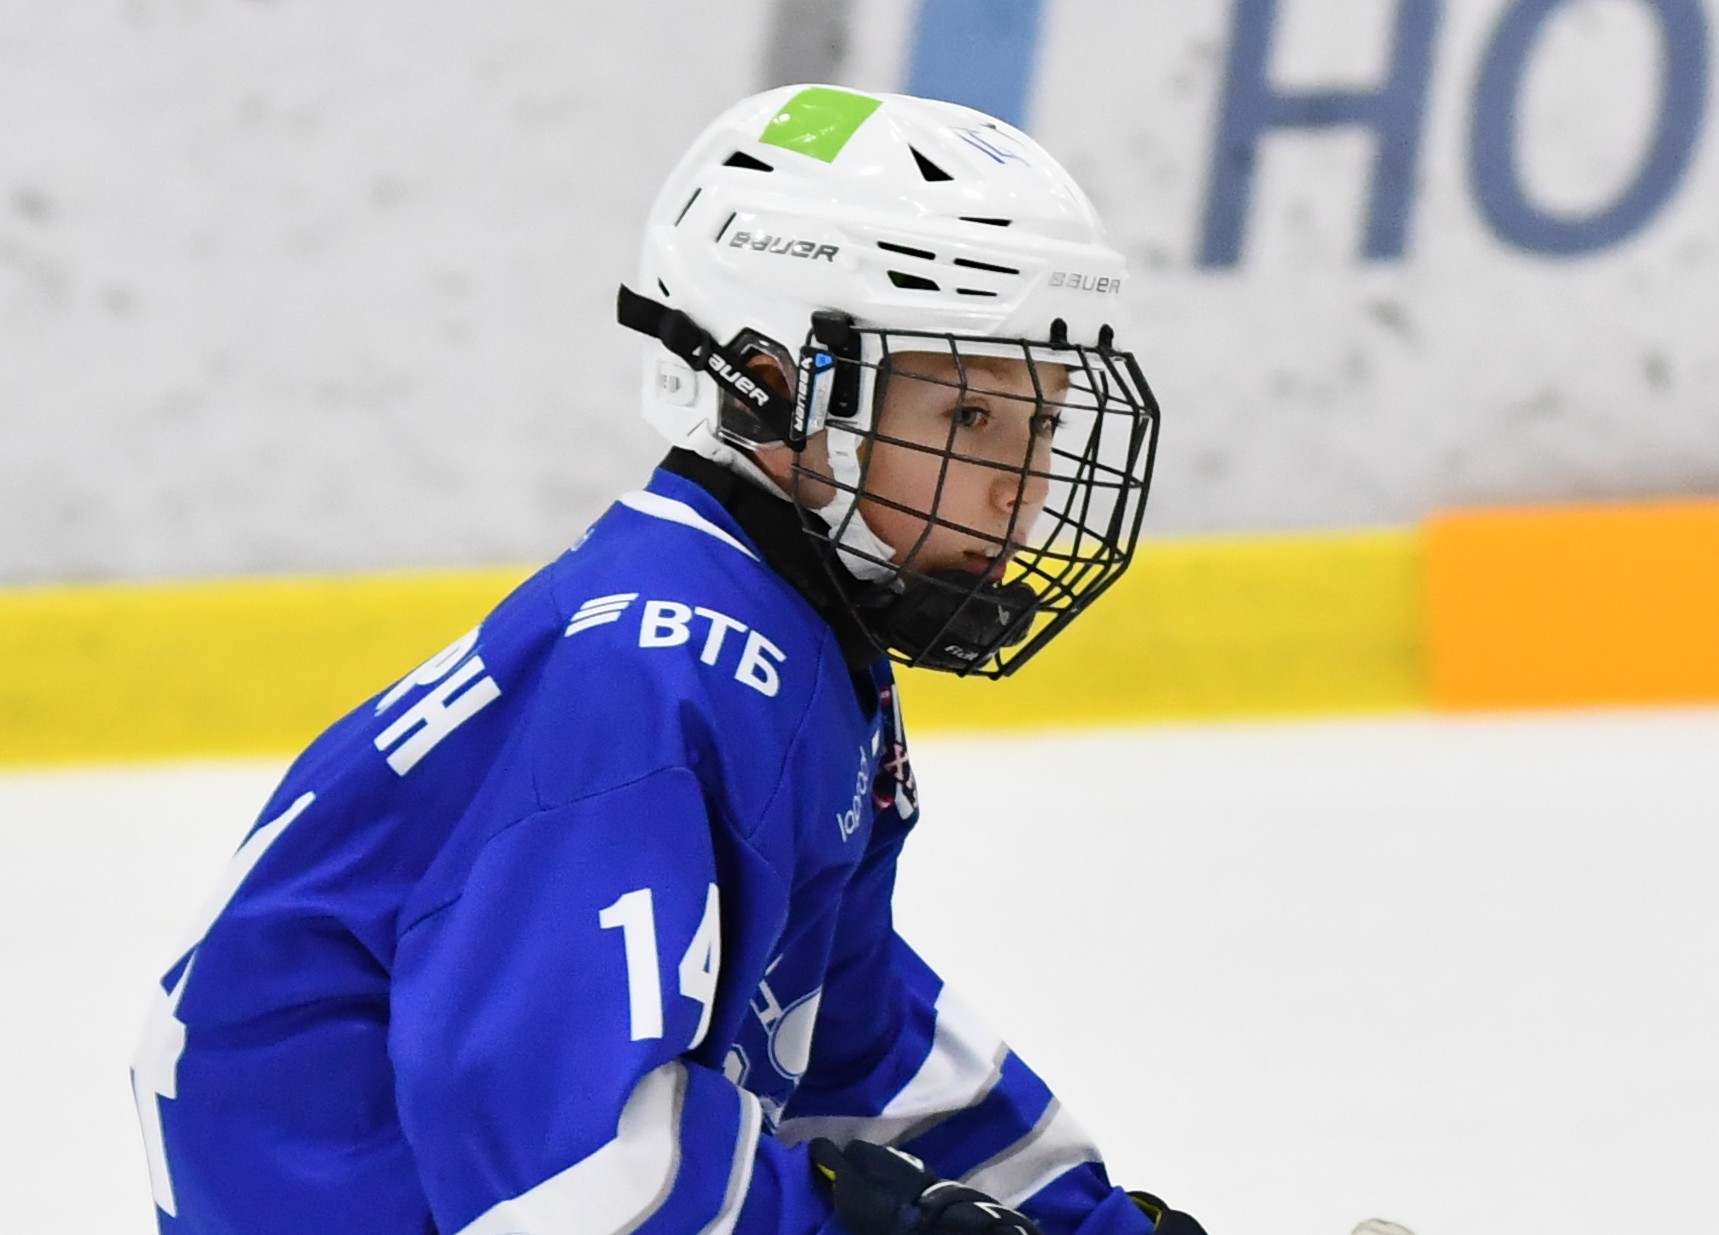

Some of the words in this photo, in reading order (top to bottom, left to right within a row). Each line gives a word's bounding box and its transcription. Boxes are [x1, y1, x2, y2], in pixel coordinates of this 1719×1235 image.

[729, 231, 840, 262] BAUER
[1047, 271, 1121, 294] BAUER
[708, 353, 770, 407] AUER
[600, 882, 721, 1049] 14
